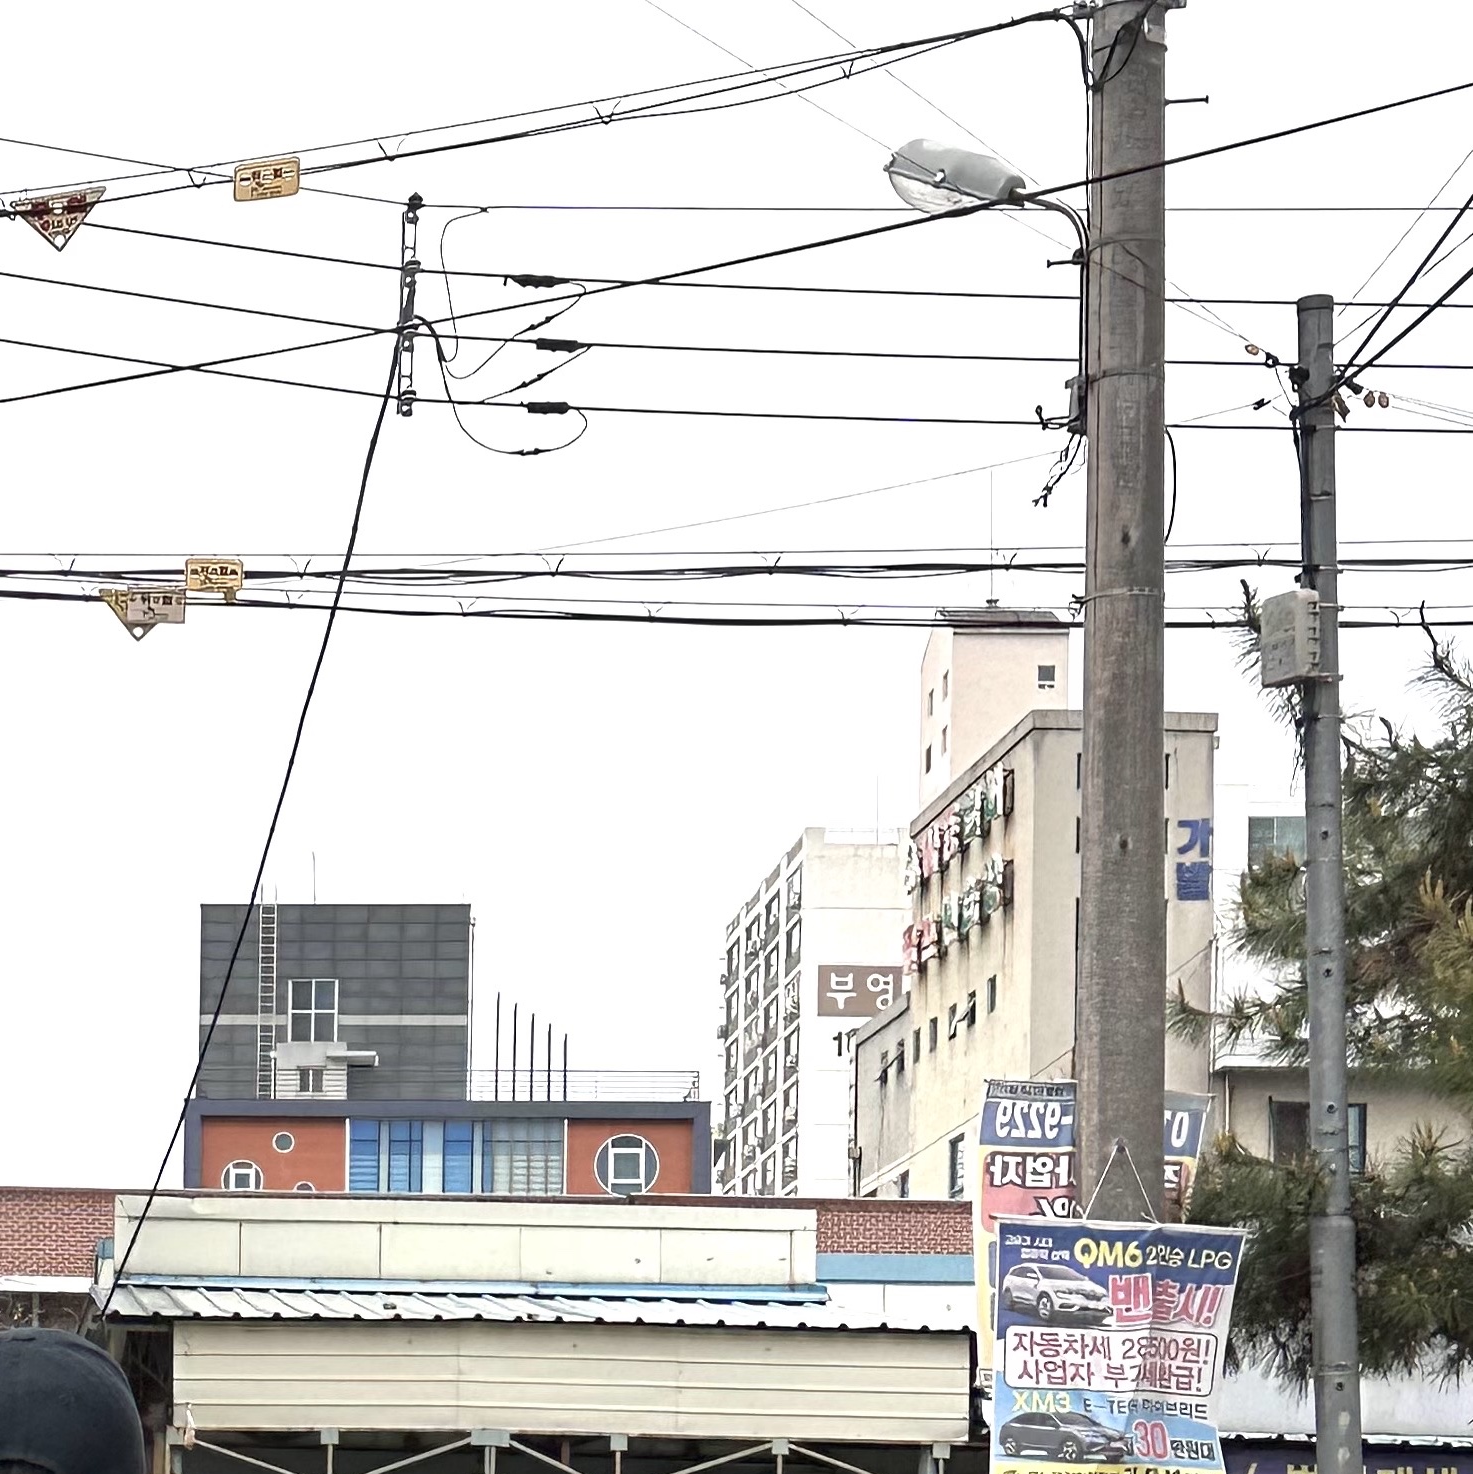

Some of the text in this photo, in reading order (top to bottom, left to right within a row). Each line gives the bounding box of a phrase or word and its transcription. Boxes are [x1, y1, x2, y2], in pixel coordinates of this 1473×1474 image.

[1074, 1238, 1143, 1268] QM6
[1146, 1246, 1184, 1267] 2인승
[1188, 1248, 1233, 1269] LPG
[1013, 1331, 1111, 1361] 자동차세
[1017, 1359, 1094, 1387] 사업자
[1012, 1390, 1070, 1413] XM3
